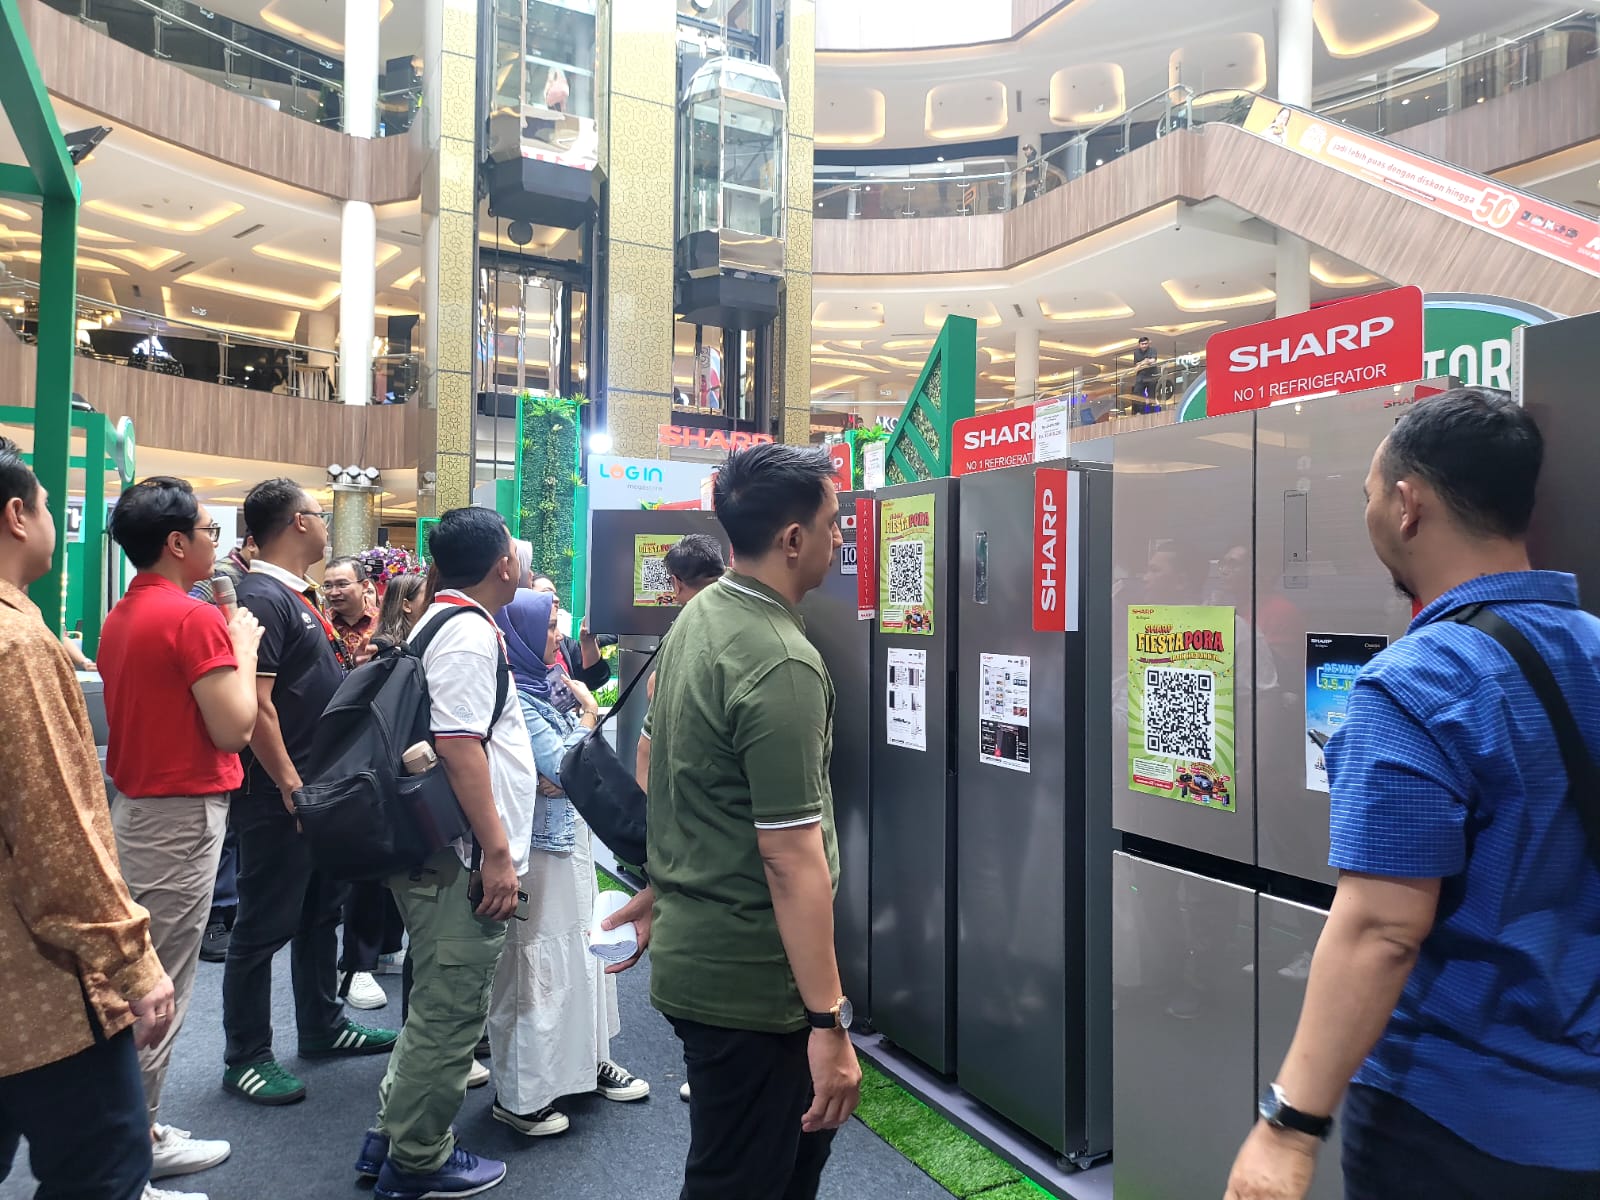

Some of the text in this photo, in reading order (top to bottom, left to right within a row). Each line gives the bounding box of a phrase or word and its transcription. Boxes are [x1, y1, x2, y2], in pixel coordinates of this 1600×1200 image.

[1333, 143, 1348, 154] jadi
[1349, 147, 1367, 160] lebih
[1367, 157, 1386, 169] puas
[1387, 163, 1416, 181] dengan
[1445, 186, 1476, 205] hingga
[1229, 316, 1394, 373] SHARP
[1234, 363, 1387, 402] NO 1 REFRIGERATOR
[966, 461, 977, 471] NO
[984, 452, 1033, 469] REFRIGERAT
[843, 547, 857, 563] 10
[1041, 488, 1057, 612] SHARP
